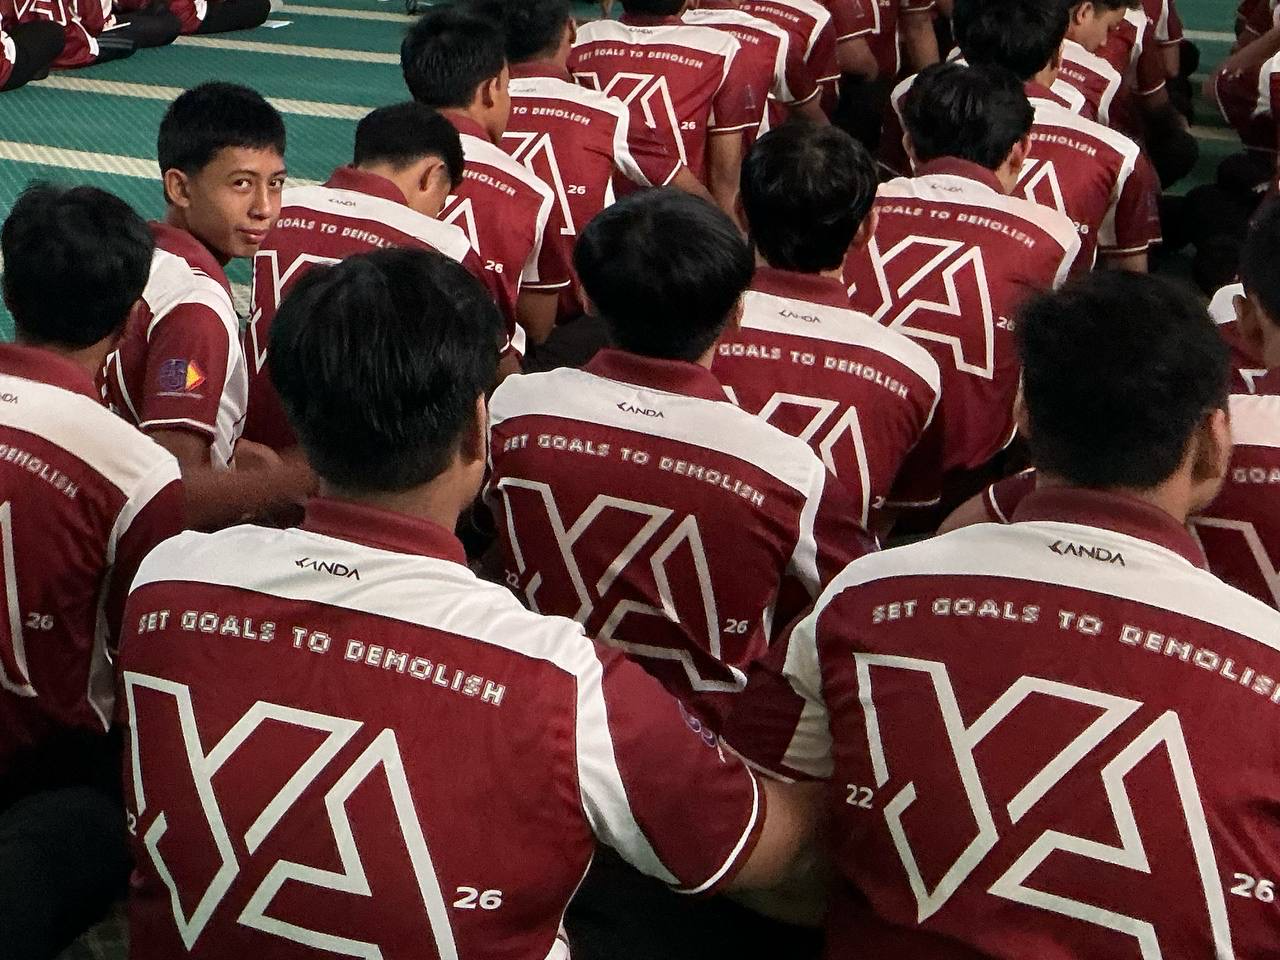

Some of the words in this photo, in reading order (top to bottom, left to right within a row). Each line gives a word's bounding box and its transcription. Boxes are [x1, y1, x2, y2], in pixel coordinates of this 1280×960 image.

[647, 50, 705, 70] DEMOLISH
[532, 106, 592, 127] DEMOLISH
[681, 121, 697, 131] 26
[567, 184, 587, 196] 26
[320, 222, 338, 235] TO
[956, 212, 1038, 250] DEMOLISH
[484, 259, 504, 274] 26
[718, 342, 783, 360] GOALS
[789, 350, 817, 367] TO
[824, 354, 910, 401] DEMOLISH
[536, 432, 611, 458] GOALS
[620, 446, 650, 466] TO
[657, 454, 768, 509] DEMOLISH
[723, 617, 750, 636] 26
[871, 597, 920, 624] SET
[930, 596, 1041, 624] GOALS
[1057, 608, 1104, 637] TO
[137, 609, 171, 635] SET
[180, 609, 276, 642] GOALS
[291, 627, 332, 654] TO
[343, 640, 507, 706] DEMOLISH
[844, 782, 875, 810] 22
[1229, 871, 1277, 905] 26
[452, 885, 503, 911] 26
